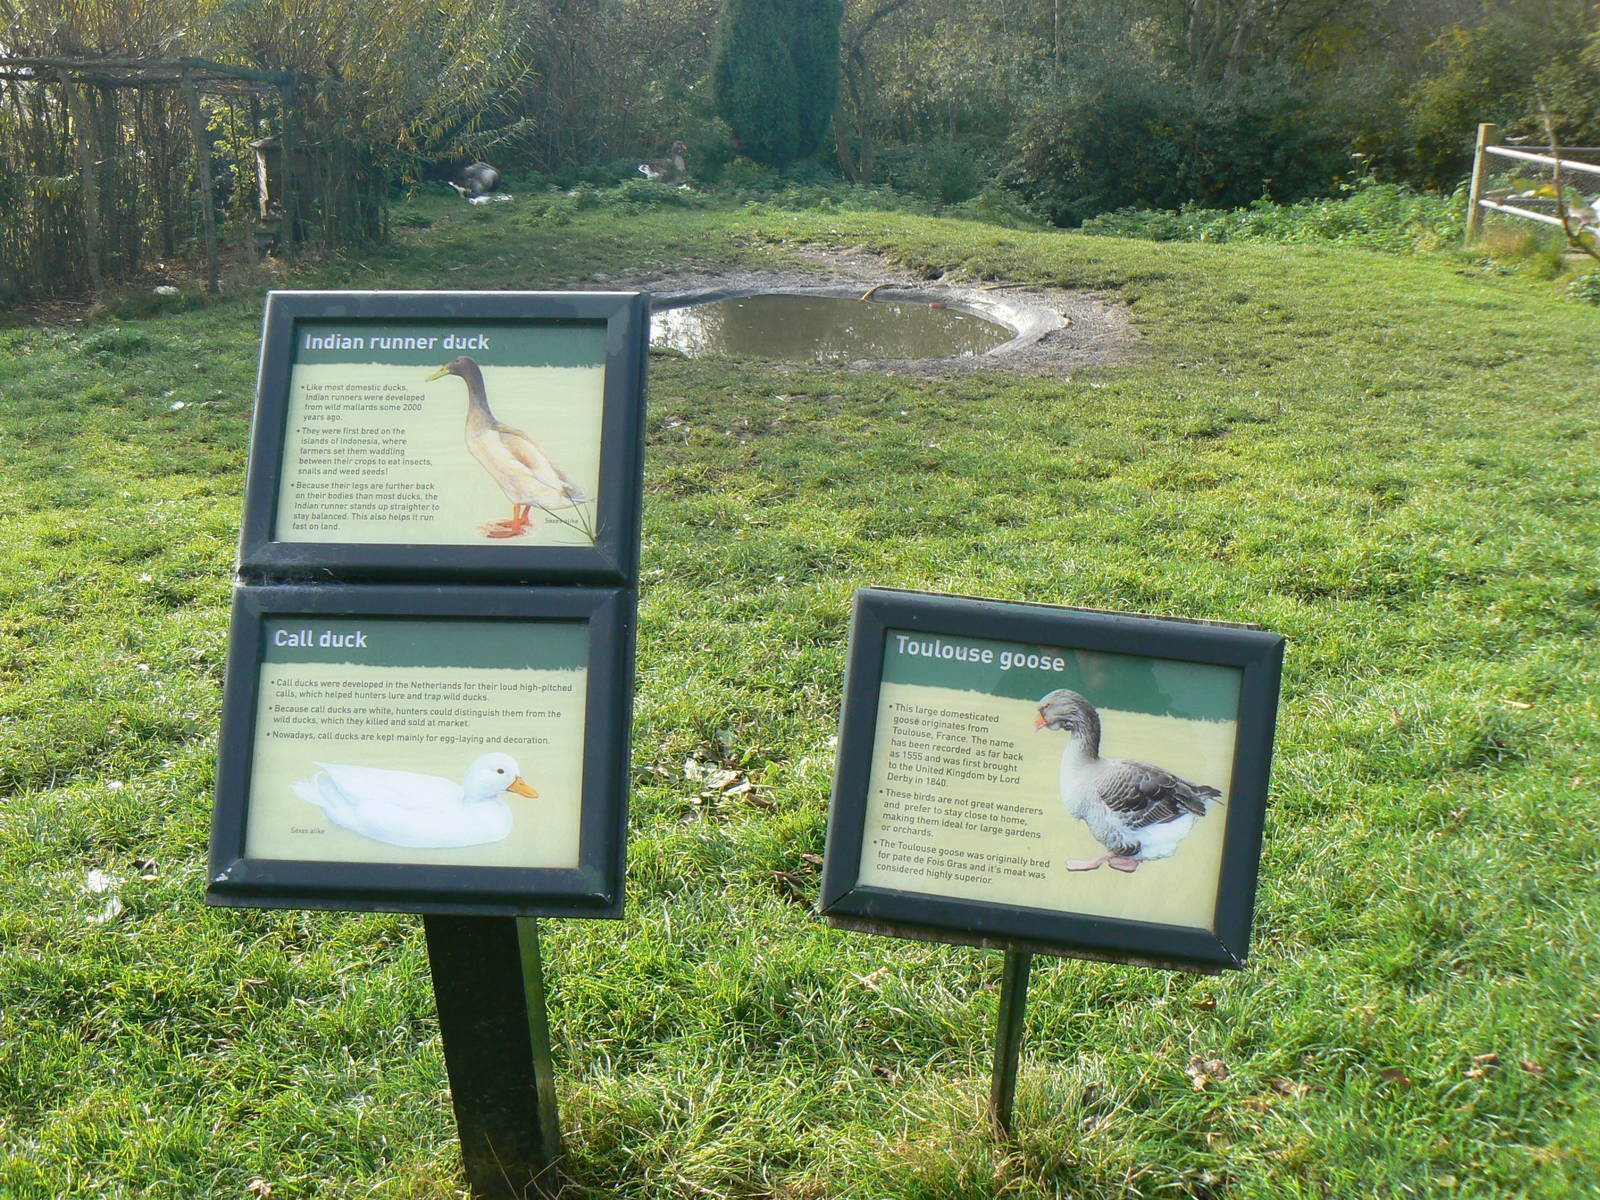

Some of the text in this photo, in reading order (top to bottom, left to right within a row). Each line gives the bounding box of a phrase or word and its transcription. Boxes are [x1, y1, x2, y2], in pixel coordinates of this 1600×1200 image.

[305, 334, 490, 349] Indian runner duck
[306, 382, 322, 391] Like
[325, 382, 344, 391] most
[346, 382, 381, 391] domestic
[305, 402, 322, 410] from
[325, 402, 341, 410] wild
[343, 402, 378, 410] mallards
[402, 402, 422, 410] 2000
[306, 392, 330, 401] Indian
[385, 392, 425, 402] developed
[303, 414, 324, 423] years
[302, 426, 319, 436] They
[343, 426, 359, 434] first
[361, 426, 378, 434] bred
[393, 426, 405, 434] the
[275, 629, 368, 648] Call duck
[896, 635, 1065, 672] Toulouse goose
[276, 688, 489, 702] calls, which helped hunters lure and trap wild ducks.
[277, 678, 292, 686] Call
[295, 678, 318, 687] ducks
[343, 679, 383, 690] developed
[386, 680, 393, 688] in
[396, 680, 408, 688] the
[411, 680, 461, 690] Netherlands
[464, 681, 476, 690] for
[478, 682, 497, 690] their
[500, 682, 517, 691] loud
[520, 682, 572, 693] high-pitched
[275, 704, 308, 713] Because
[311, 705, 325, 713] call
[327, 705, 351, 714] ducks
[369, 706, 393, 716] white,
[396, 706, 428, 715] hunters
[430, 707, 452, 715] could
[455, 707, 499, 718] distinguish
[502, 708, 523, 717] them
[526, 708, 545, 717] from
[548, 709, 561, 717] the
[895, 701, 999, 723] This large domesticated
[274, 715, 470, 727] wild ducks, which they killed and sold at market.
[894, 715, 988, 734] goose originates from
[273, 730, 315, 741] Nowadays,
[318, 731, 332, 739] call
[334, 731, 358, 740] ducks
[377, 732, 394, 743] kept
[397, 733, 425, 743] mainly
[426, 733, 438, 742] for
[441, 734, 483, 745] egg-laying
[486, 735, 501, 743] and
[504, 735, 550, 744] decoration.
[893, 725, 1014, 749] Toulouse, France. The name
[891, 736, 1023, 761] has been recorded as far back
[890, 749, 1017, 773] as 1555 and was first brought
[888, 771, 948, 787] Derby in 1840.
[889, 759, 1020, 784] to the United Kingdom by Lord
[885, 787, 1043, 816] These birds are not great wanderers
[884, 800, 1027, 827] and prefer to stay close to home,
[881, 824, 933, 837] or orchards.
[883, 811, 1041, 839] making them ideal for large gardens
[880, 837, 1049, 868] The Toulouse goose was originally bred
[877, 862, 992, 885] considered highly superior.
[878, 849, 1046, 880] for pate de Fois Gras and it's meat was
